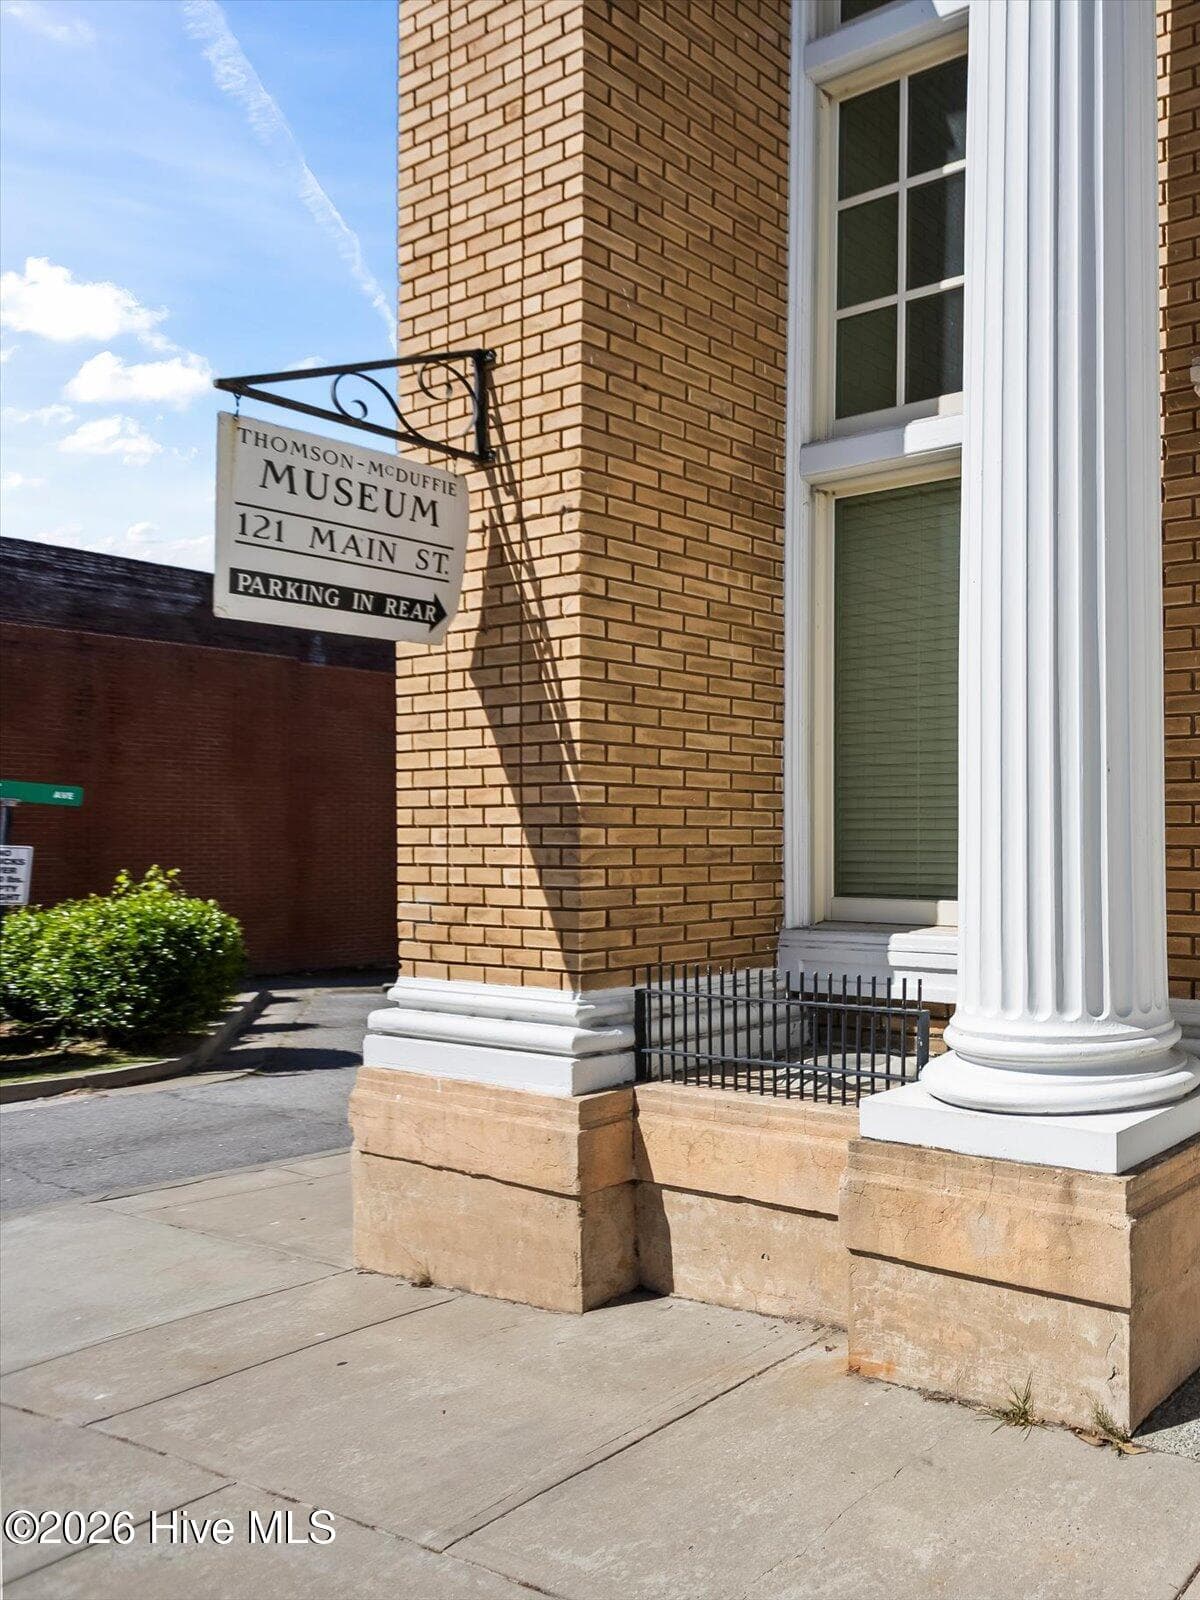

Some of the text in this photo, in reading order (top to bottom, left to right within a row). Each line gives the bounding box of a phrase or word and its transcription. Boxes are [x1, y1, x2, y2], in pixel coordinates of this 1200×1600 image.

[259, 459, 440, 528] MUSEUM
[238, 512, 449, 575] 121 MAIN ST.
[237, 573, 437, 622] PARKING IN REAR
